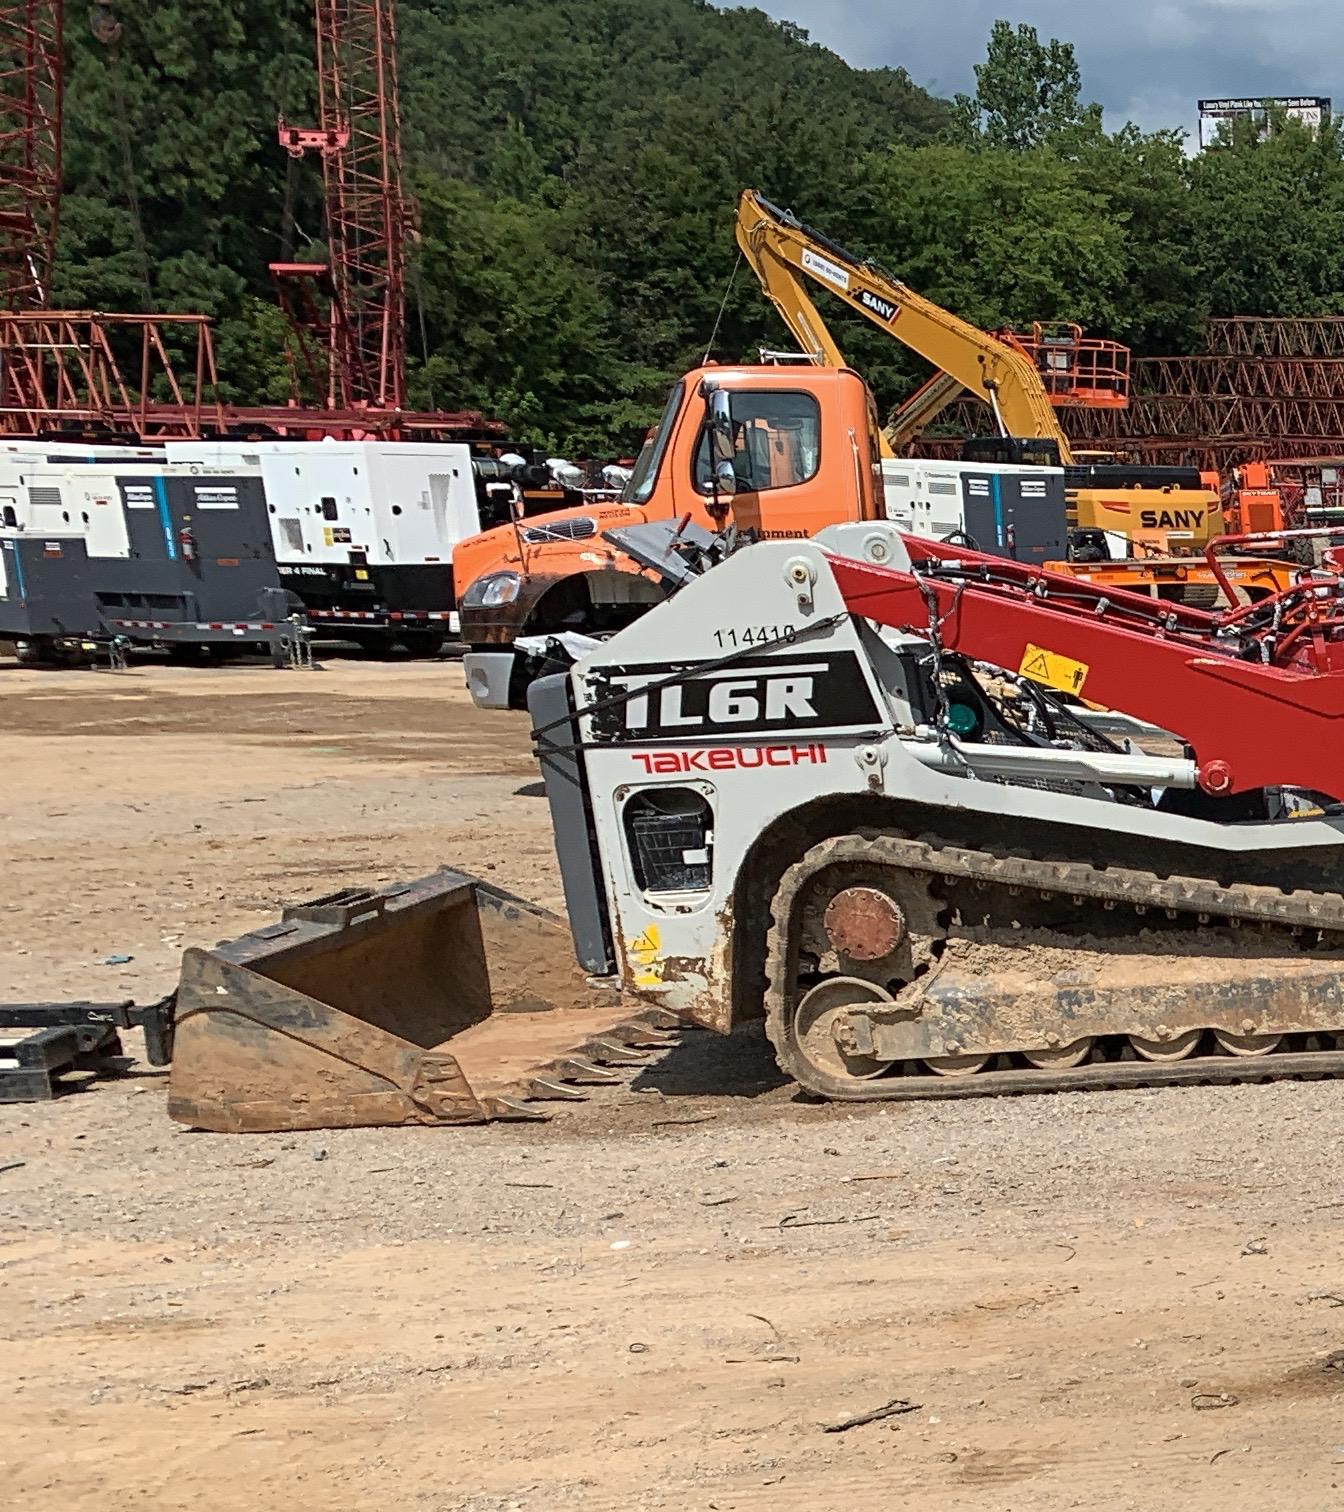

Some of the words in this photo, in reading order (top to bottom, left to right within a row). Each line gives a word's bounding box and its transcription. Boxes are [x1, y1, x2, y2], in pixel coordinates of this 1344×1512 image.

[862, 292, 893, 318] SANY
[1141, 510, 1205, 529] SANY
[714, 625, 796, 648] 114410
[610, 663, 829, 730] TL6R
